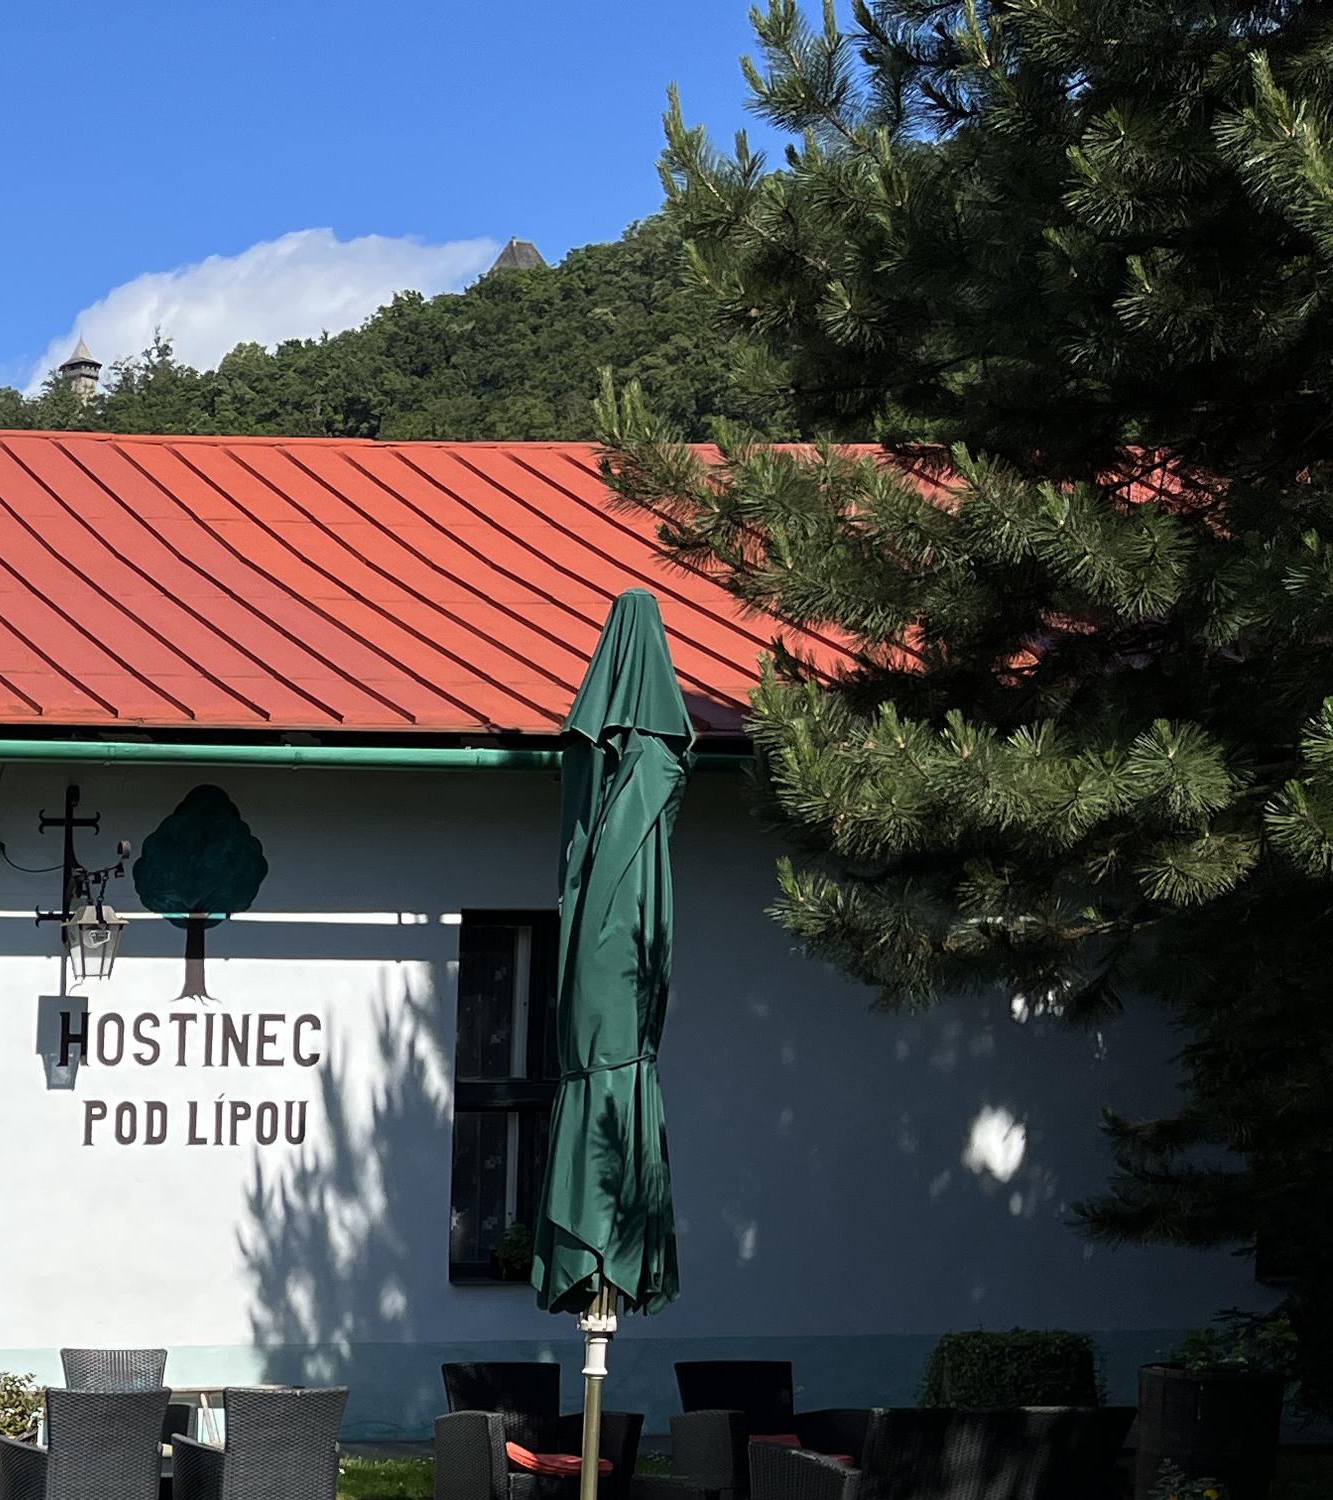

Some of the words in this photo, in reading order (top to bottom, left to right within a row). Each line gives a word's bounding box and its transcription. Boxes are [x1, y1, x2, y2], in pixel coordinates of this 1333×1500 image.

[55, 1011, 322, 1067] HOSTINEC
[82, 1099, 169, 1146] POD
[185, 1092, 310, 1146] LÍPOU
